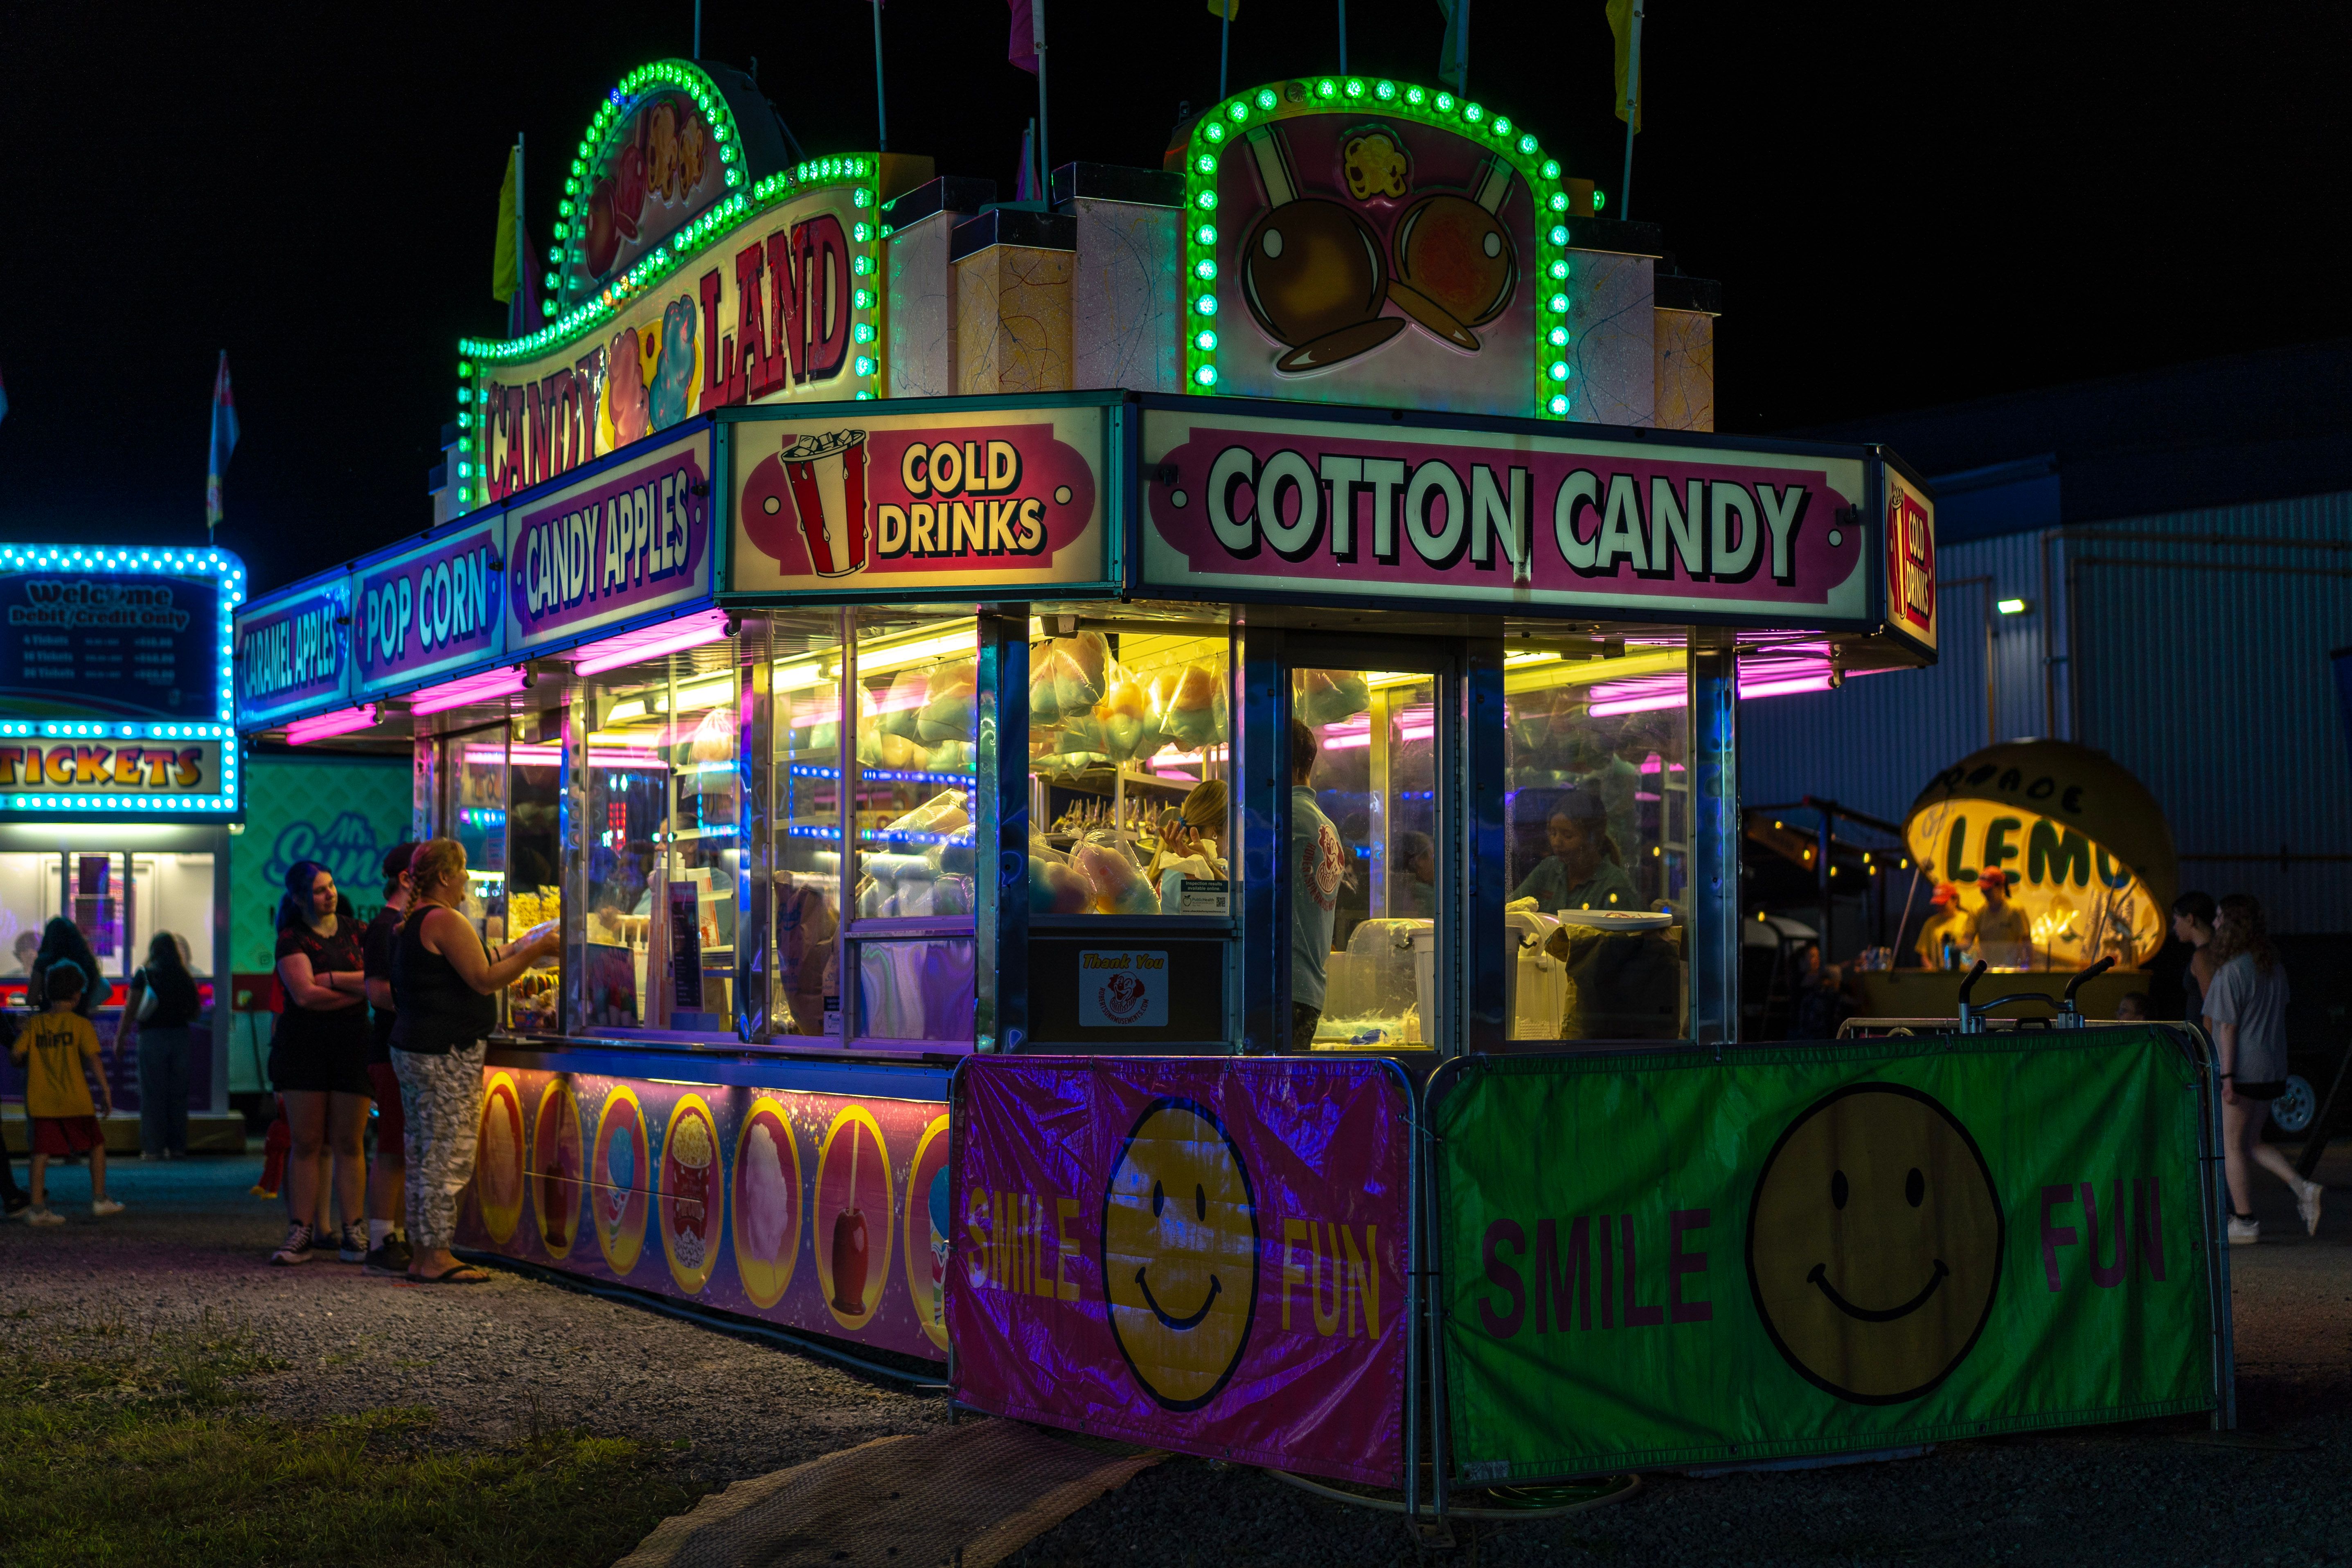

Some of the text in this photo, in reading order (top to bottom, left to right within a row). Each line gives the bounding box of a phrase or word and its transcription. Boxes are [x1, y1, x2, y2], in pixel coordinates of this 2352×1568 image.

[486, 214, 852, 502] CANDY LAND
[901, 439, 1022, 498] COLD
[525, 467, 690, 619] CANDY APPLES
[877, 498, 1046, 558] DRINKS
[1206, 445, 1811, 586] COTTON CANDY
[1909, 509, 1924, 563] COLD
[367, 545, 489, 667] POP CORN
[1906, 559, 1929, 619] DRINKS
[141, 610, 187, 631] Only
[245, 602, 337, 699] CARAMEL APPLES
[0, 744, 203, 786] TICKETS
[1084, 953, 1164, 969] Thank You
[1098, 987, 1149, 1024] ROBERTSONAMUSEMENTS.COM
[967, 1187, 1380, 1340] SMILE FUN
[1477, 1176, 2166, 1340] SMILE FUN
